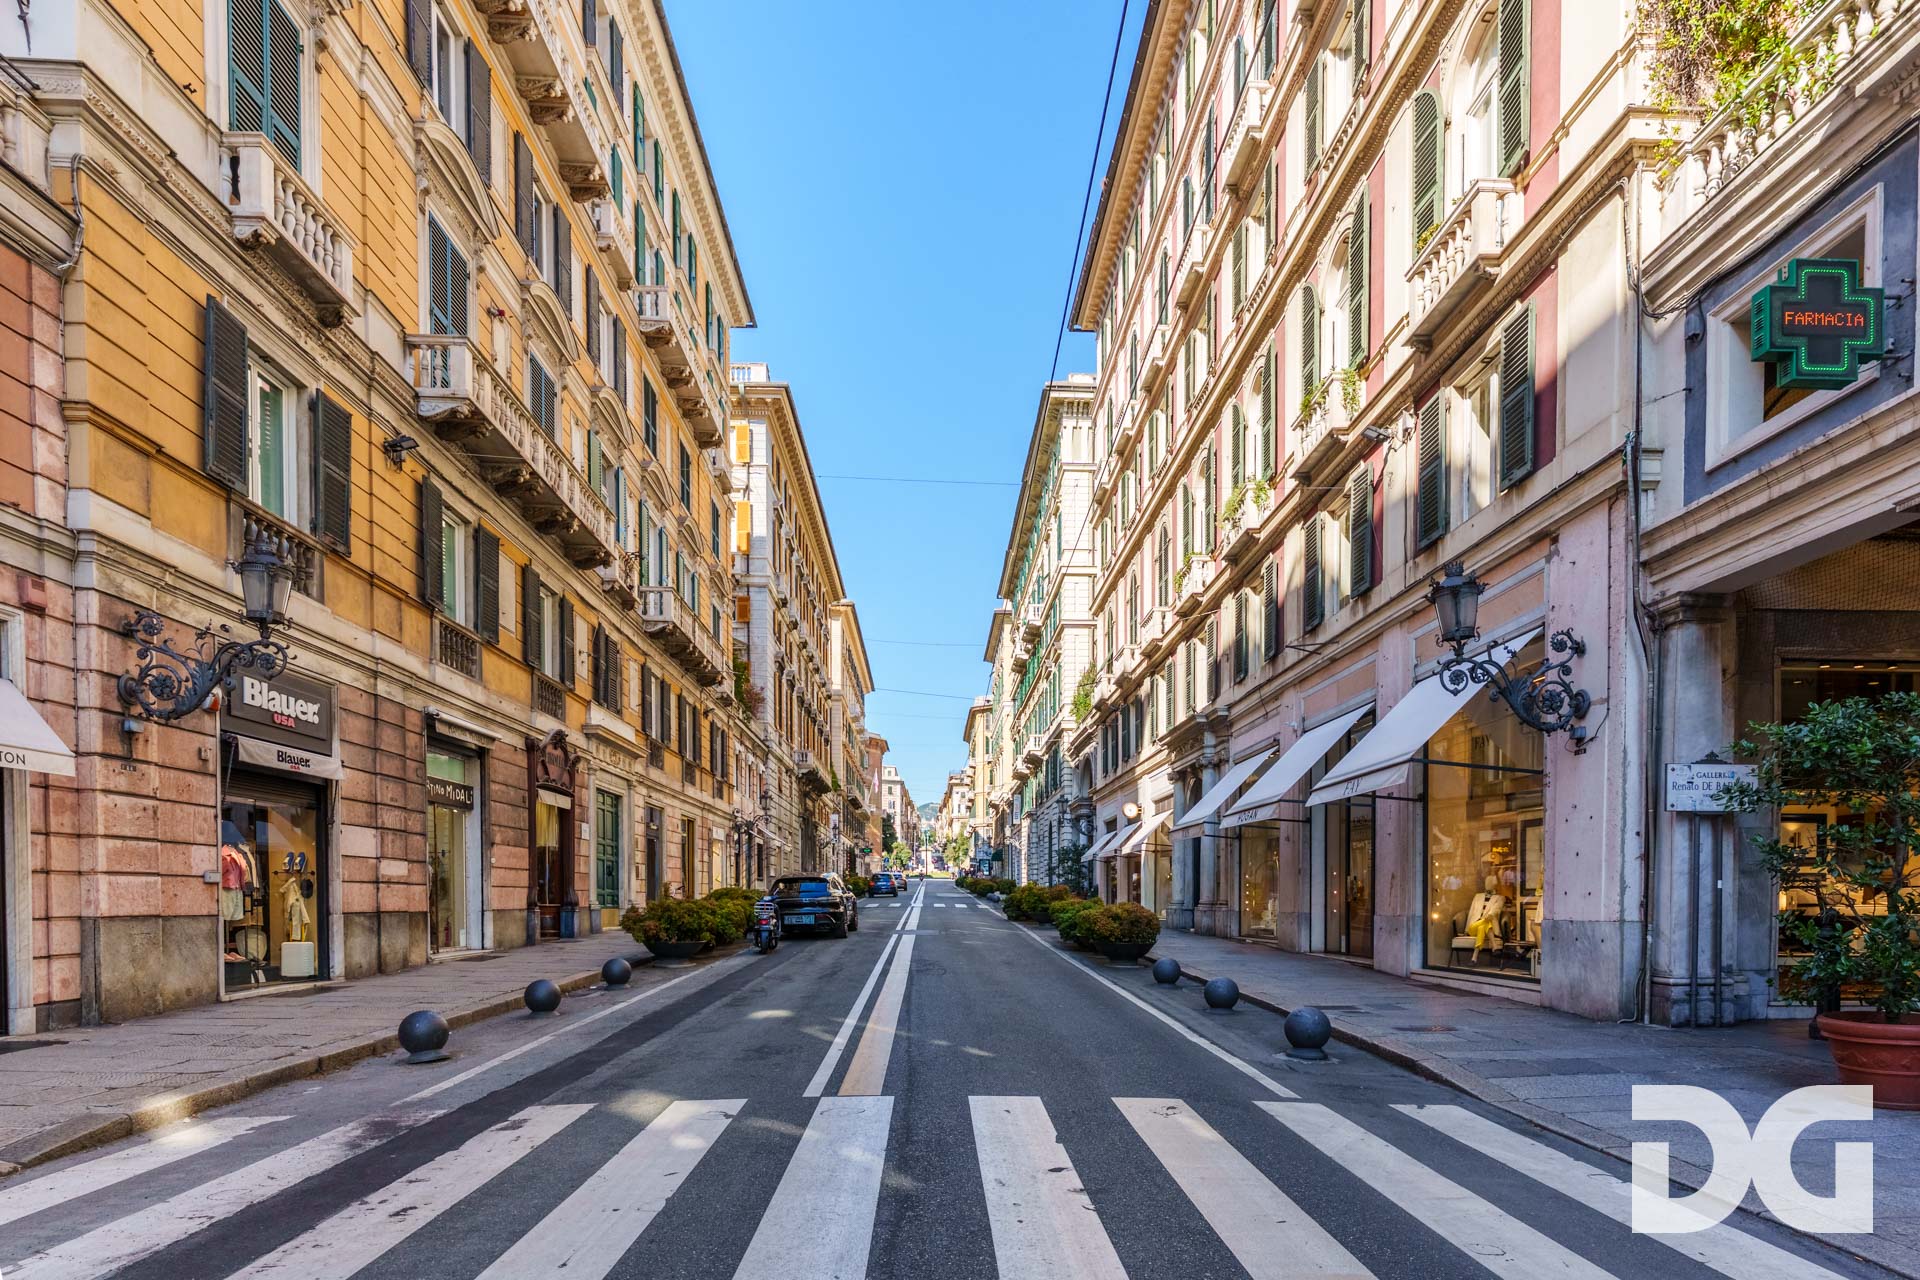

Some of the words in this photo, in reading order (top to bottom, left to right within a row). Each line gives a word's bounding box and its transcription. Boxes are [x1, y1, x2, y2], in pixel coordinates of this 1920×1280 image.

[1784, 311, 1865, 327] FARMACIA
[273, 713, 295, 728] USA
[1343, 777, 1364, 796] FAY
[1702, 781, 1713, 791] DE
